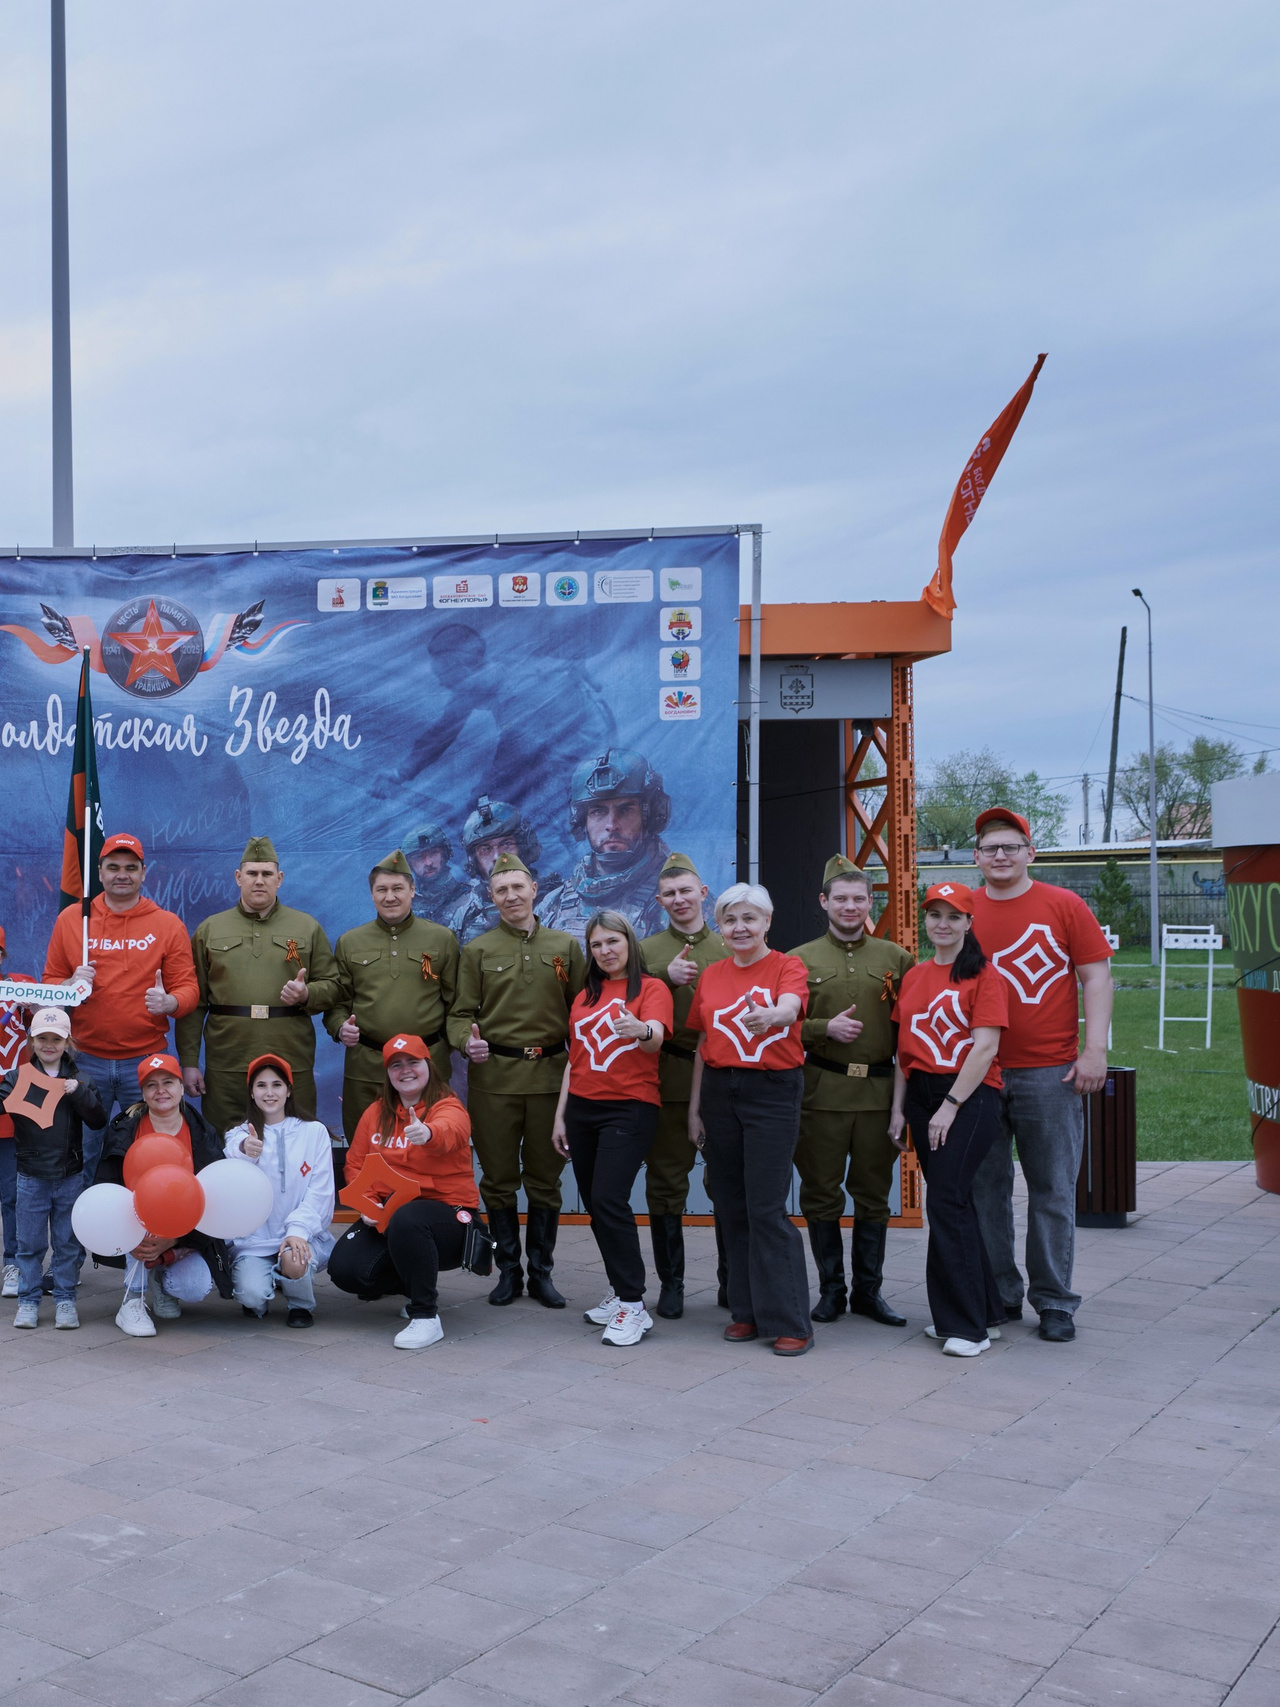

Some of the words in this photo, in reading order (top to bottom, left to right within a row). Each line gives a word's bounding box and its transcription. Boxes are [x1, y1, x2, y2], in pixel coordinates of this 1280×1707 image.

[117, 607, 139, 626] ЧЕСТЬ
[160, 603, 188, 626] ПАМЯТЬ
[182, 645, 200, 654] 2025
[135, 680, 170, 692] ТРАДИЦИИ
[225, 685, 361, 765] Звезда
